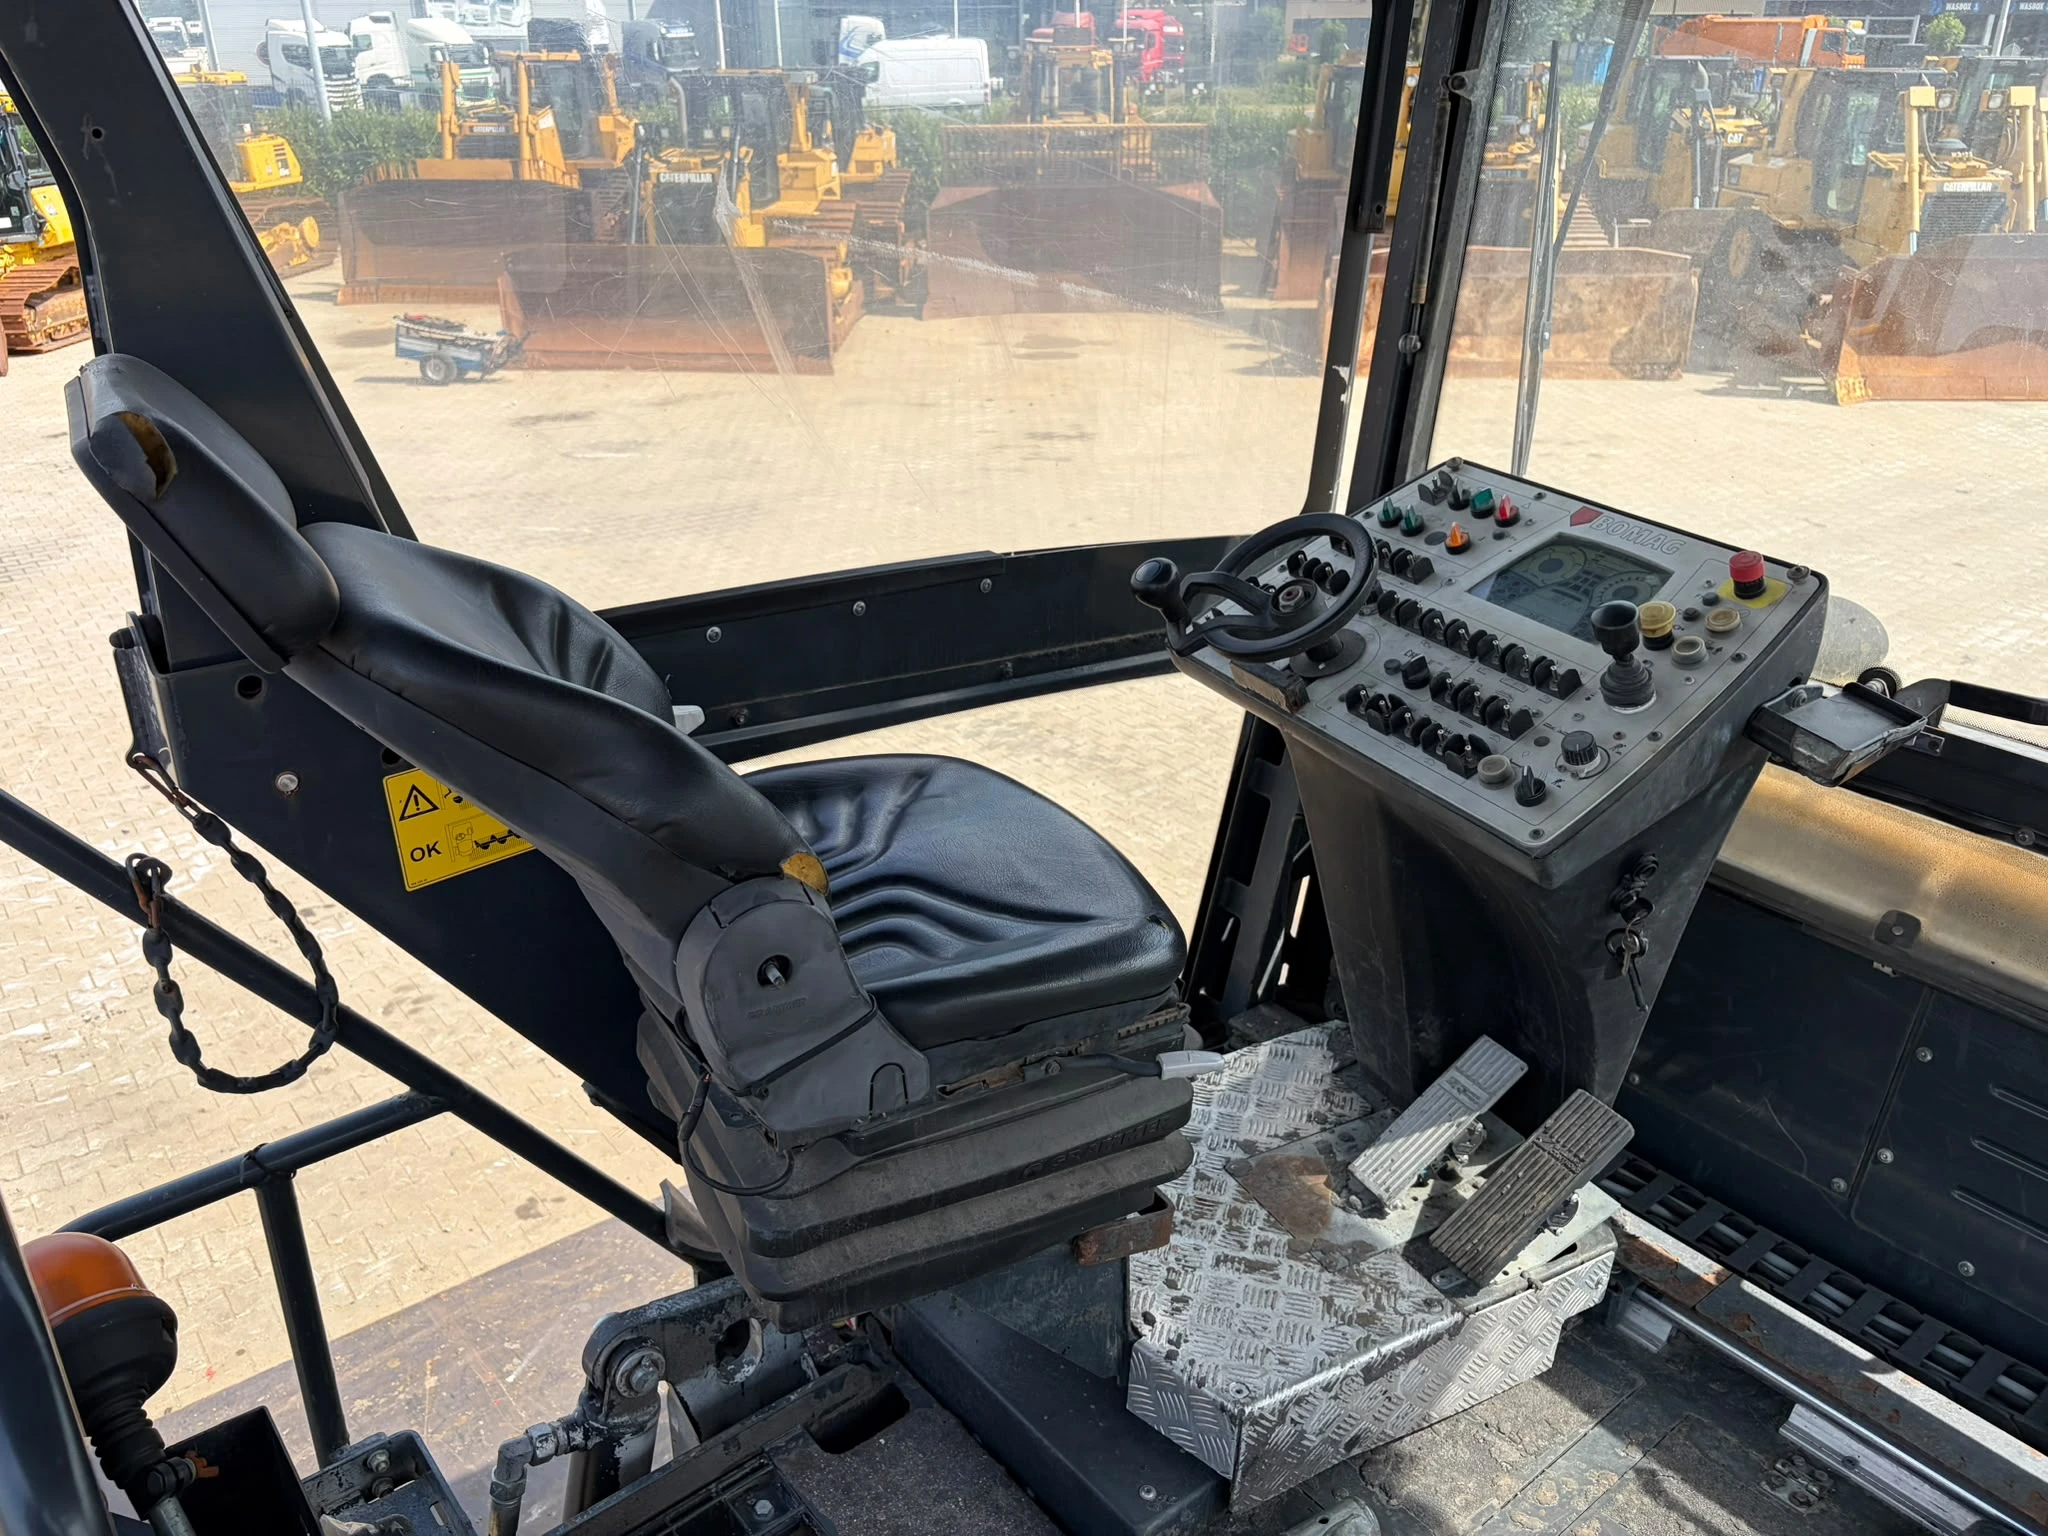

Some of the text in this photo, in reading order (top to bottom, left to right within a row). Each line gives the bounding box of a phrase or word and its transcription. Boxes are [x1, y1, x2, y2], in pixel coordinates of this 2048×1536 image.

[1727, 132, 1744, 144] CAT
[658, 172, 713, 184] CATERPILLAR
[1943, 181, 1993, 192] CATERPILLAR
[1589, 513, 1687, 556] BOMAG
[410, 840, 442, 862] OK
